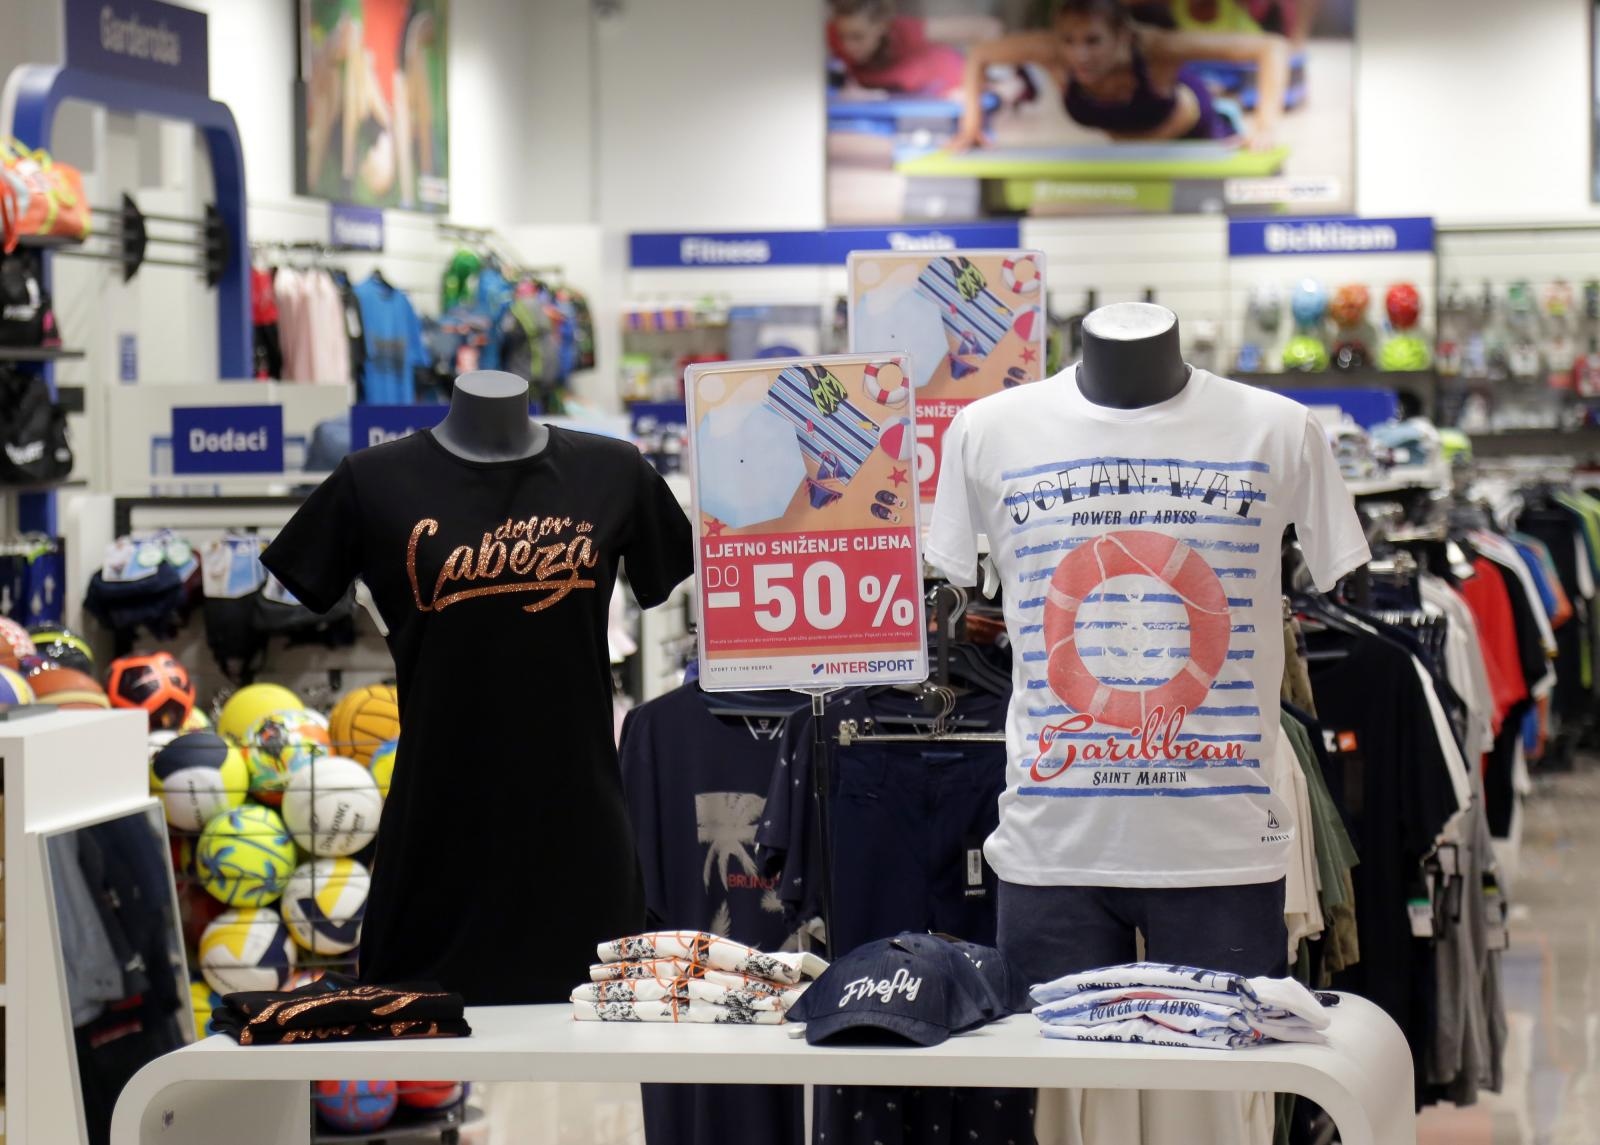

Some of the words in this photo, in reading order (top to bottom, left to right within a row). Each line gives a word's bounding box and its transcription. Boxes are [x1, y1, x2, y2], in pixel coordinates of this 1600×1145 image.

[1264, 221, 1398, 252] Biciklizam
[680, 236, 771, 264] Fitness
[916, 402, 964, 418] SNIŽE
[189, 427, 268, 453] Dodaci
[494, 515, 573, 544] dolor
[1071, 512, 1122, 527] POWER
[1129, 510, 1147, 525] OF
[1152, 510, 1198, 525] ABYSS
[706, 541, 767, 558] LJETNO
[771, 536, 849, 556] SNIŽENJE
[853, 534, 913, 551] CIJENA
[406, 518, 600, 613] Cabeza
[706, 565, 740, 588] DO
[826, 658, 915, 675] INTERSPORT
[1092, 771, 1132, 786] SAINT
[1135, 771, 1187, 787] MARTIN
[838, 967, 922, 1008] Firefly
[1089, 998, 1132, 1021] POWER
[1137, 999, 1153, 1012] OF
[1159, 1000, 1200, 1017] ABYSS
